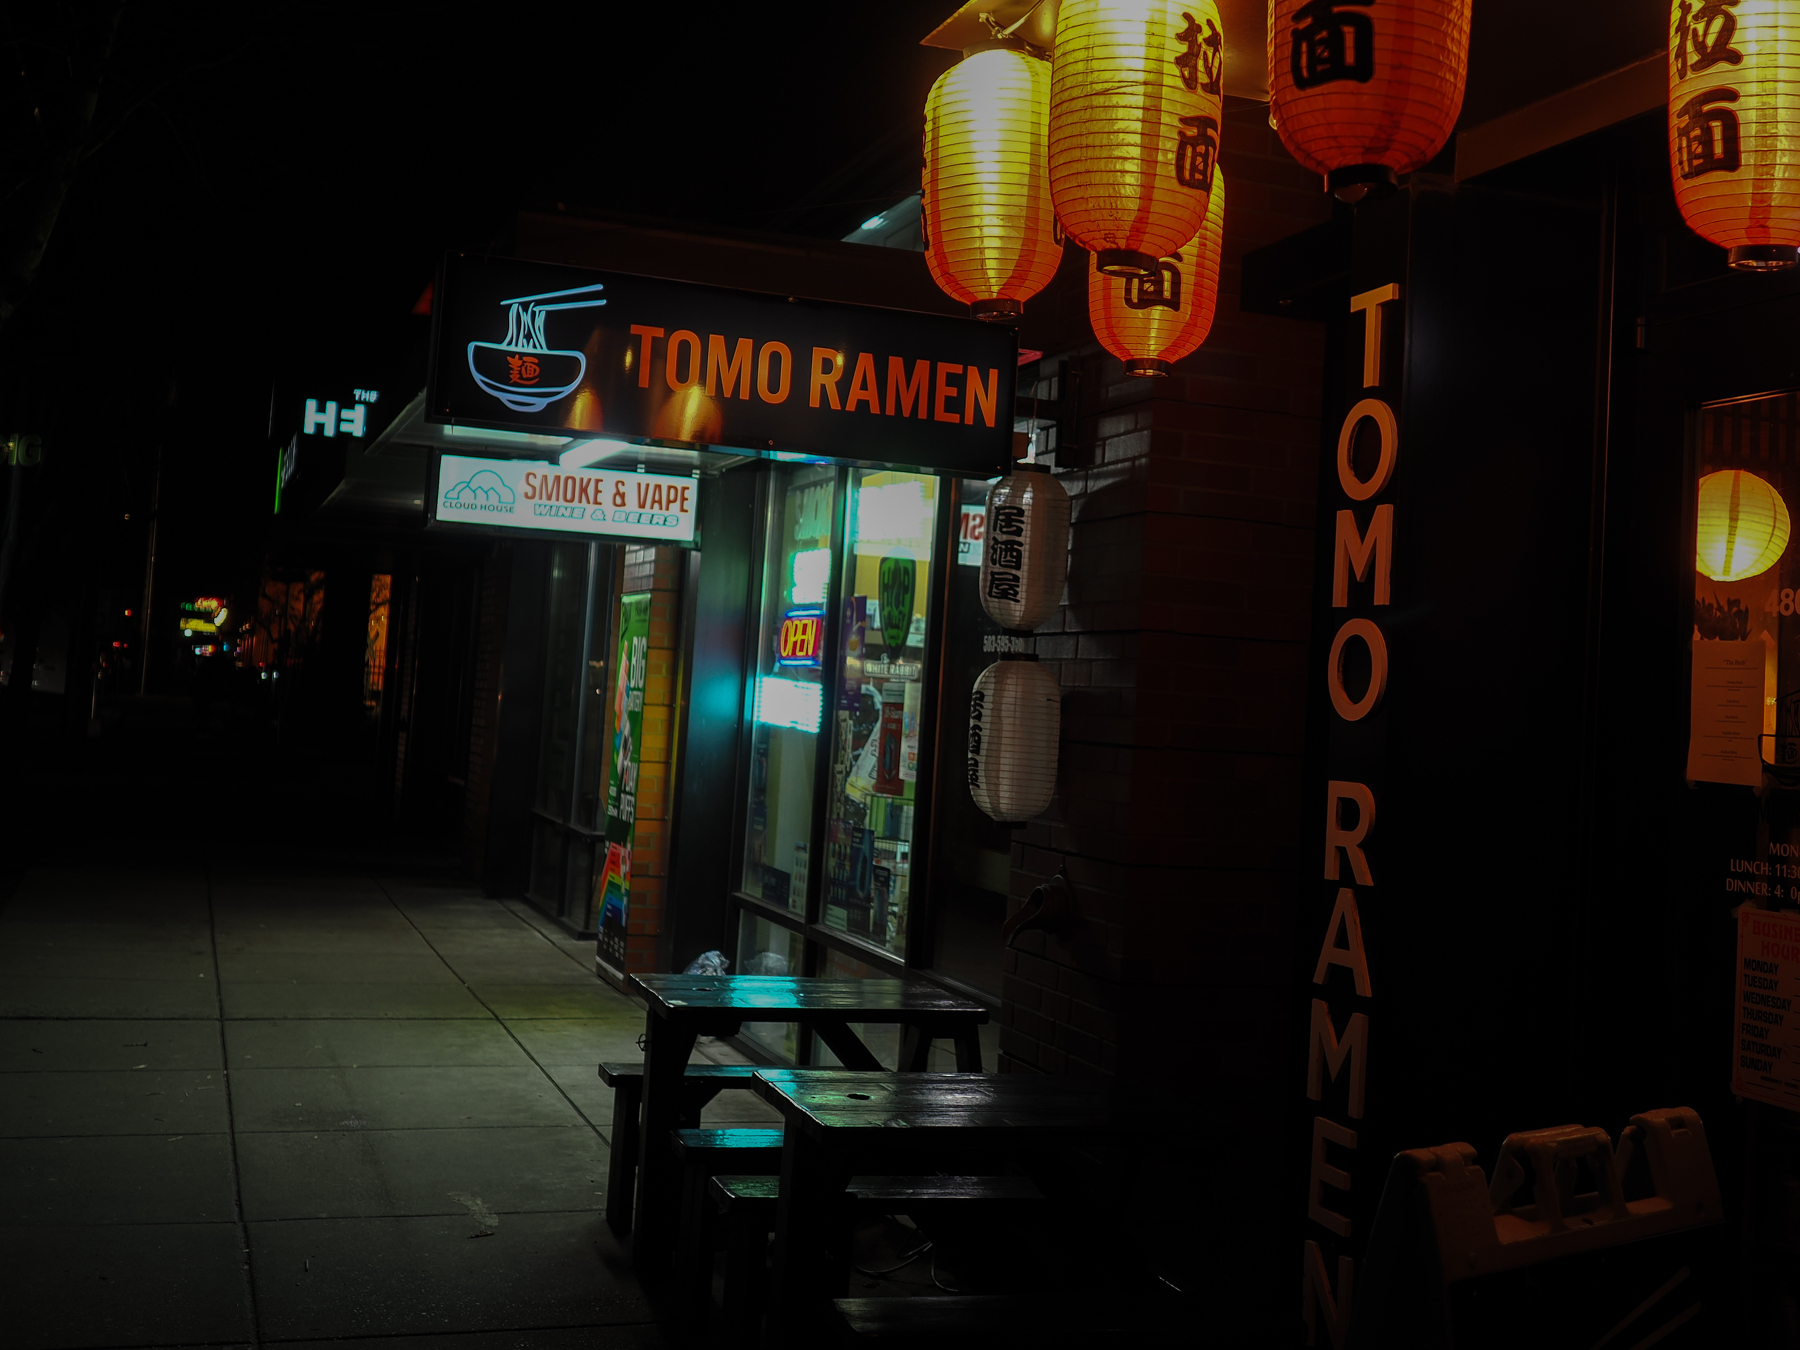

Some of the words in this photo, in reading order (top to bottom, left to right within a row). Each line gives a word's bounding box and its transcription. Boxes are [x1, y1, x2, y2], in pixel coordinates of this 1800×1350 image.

[630, 324, 792, 404] TOMO
[809, 347, 999, 427] RAMEN
[524, 472, 603, 506] SMOKE
[612, 480, 627, 507] &
[637, 482, 690, 513] VAPE
[1328, 283, 1399, 722] TOMO
[443, 501, 477, 511] CLOUD
[480, 503, 514, 513] HOUSE
[534, 503, 586, 519] WINE
[590, 508, 606, 522] &
[612, 511, 679, 527] BEERS
[988, 505, 1025, 603] 居酒屋
[780, 619, 817, 657] OPEN
[630, 636, 648, 690] BIG
[866, 663, 889, 674] WHITE
[890, 664, 917, 676] RABBIT
[1730, 858, 1772, 876] LUNCH:
[1726, 878, 1772, 896] DINNER:
[1744, 958, 1779, 976] MONDAY
[1744, 974, 1779, 992] TUESDAY
[1743, 990, 1792, 1011] WEDNESDAY
[1742, 1006, 1784, 1026] THURSDAY
[1741, 1023, 1769, 1040] FRIDAY
[1741, 1039, 1782, 1059] SATURDAY
[1302, 780, 1378, 1350] RAMEN
[1740, 1055, 1773, 1074] SUNDAY
